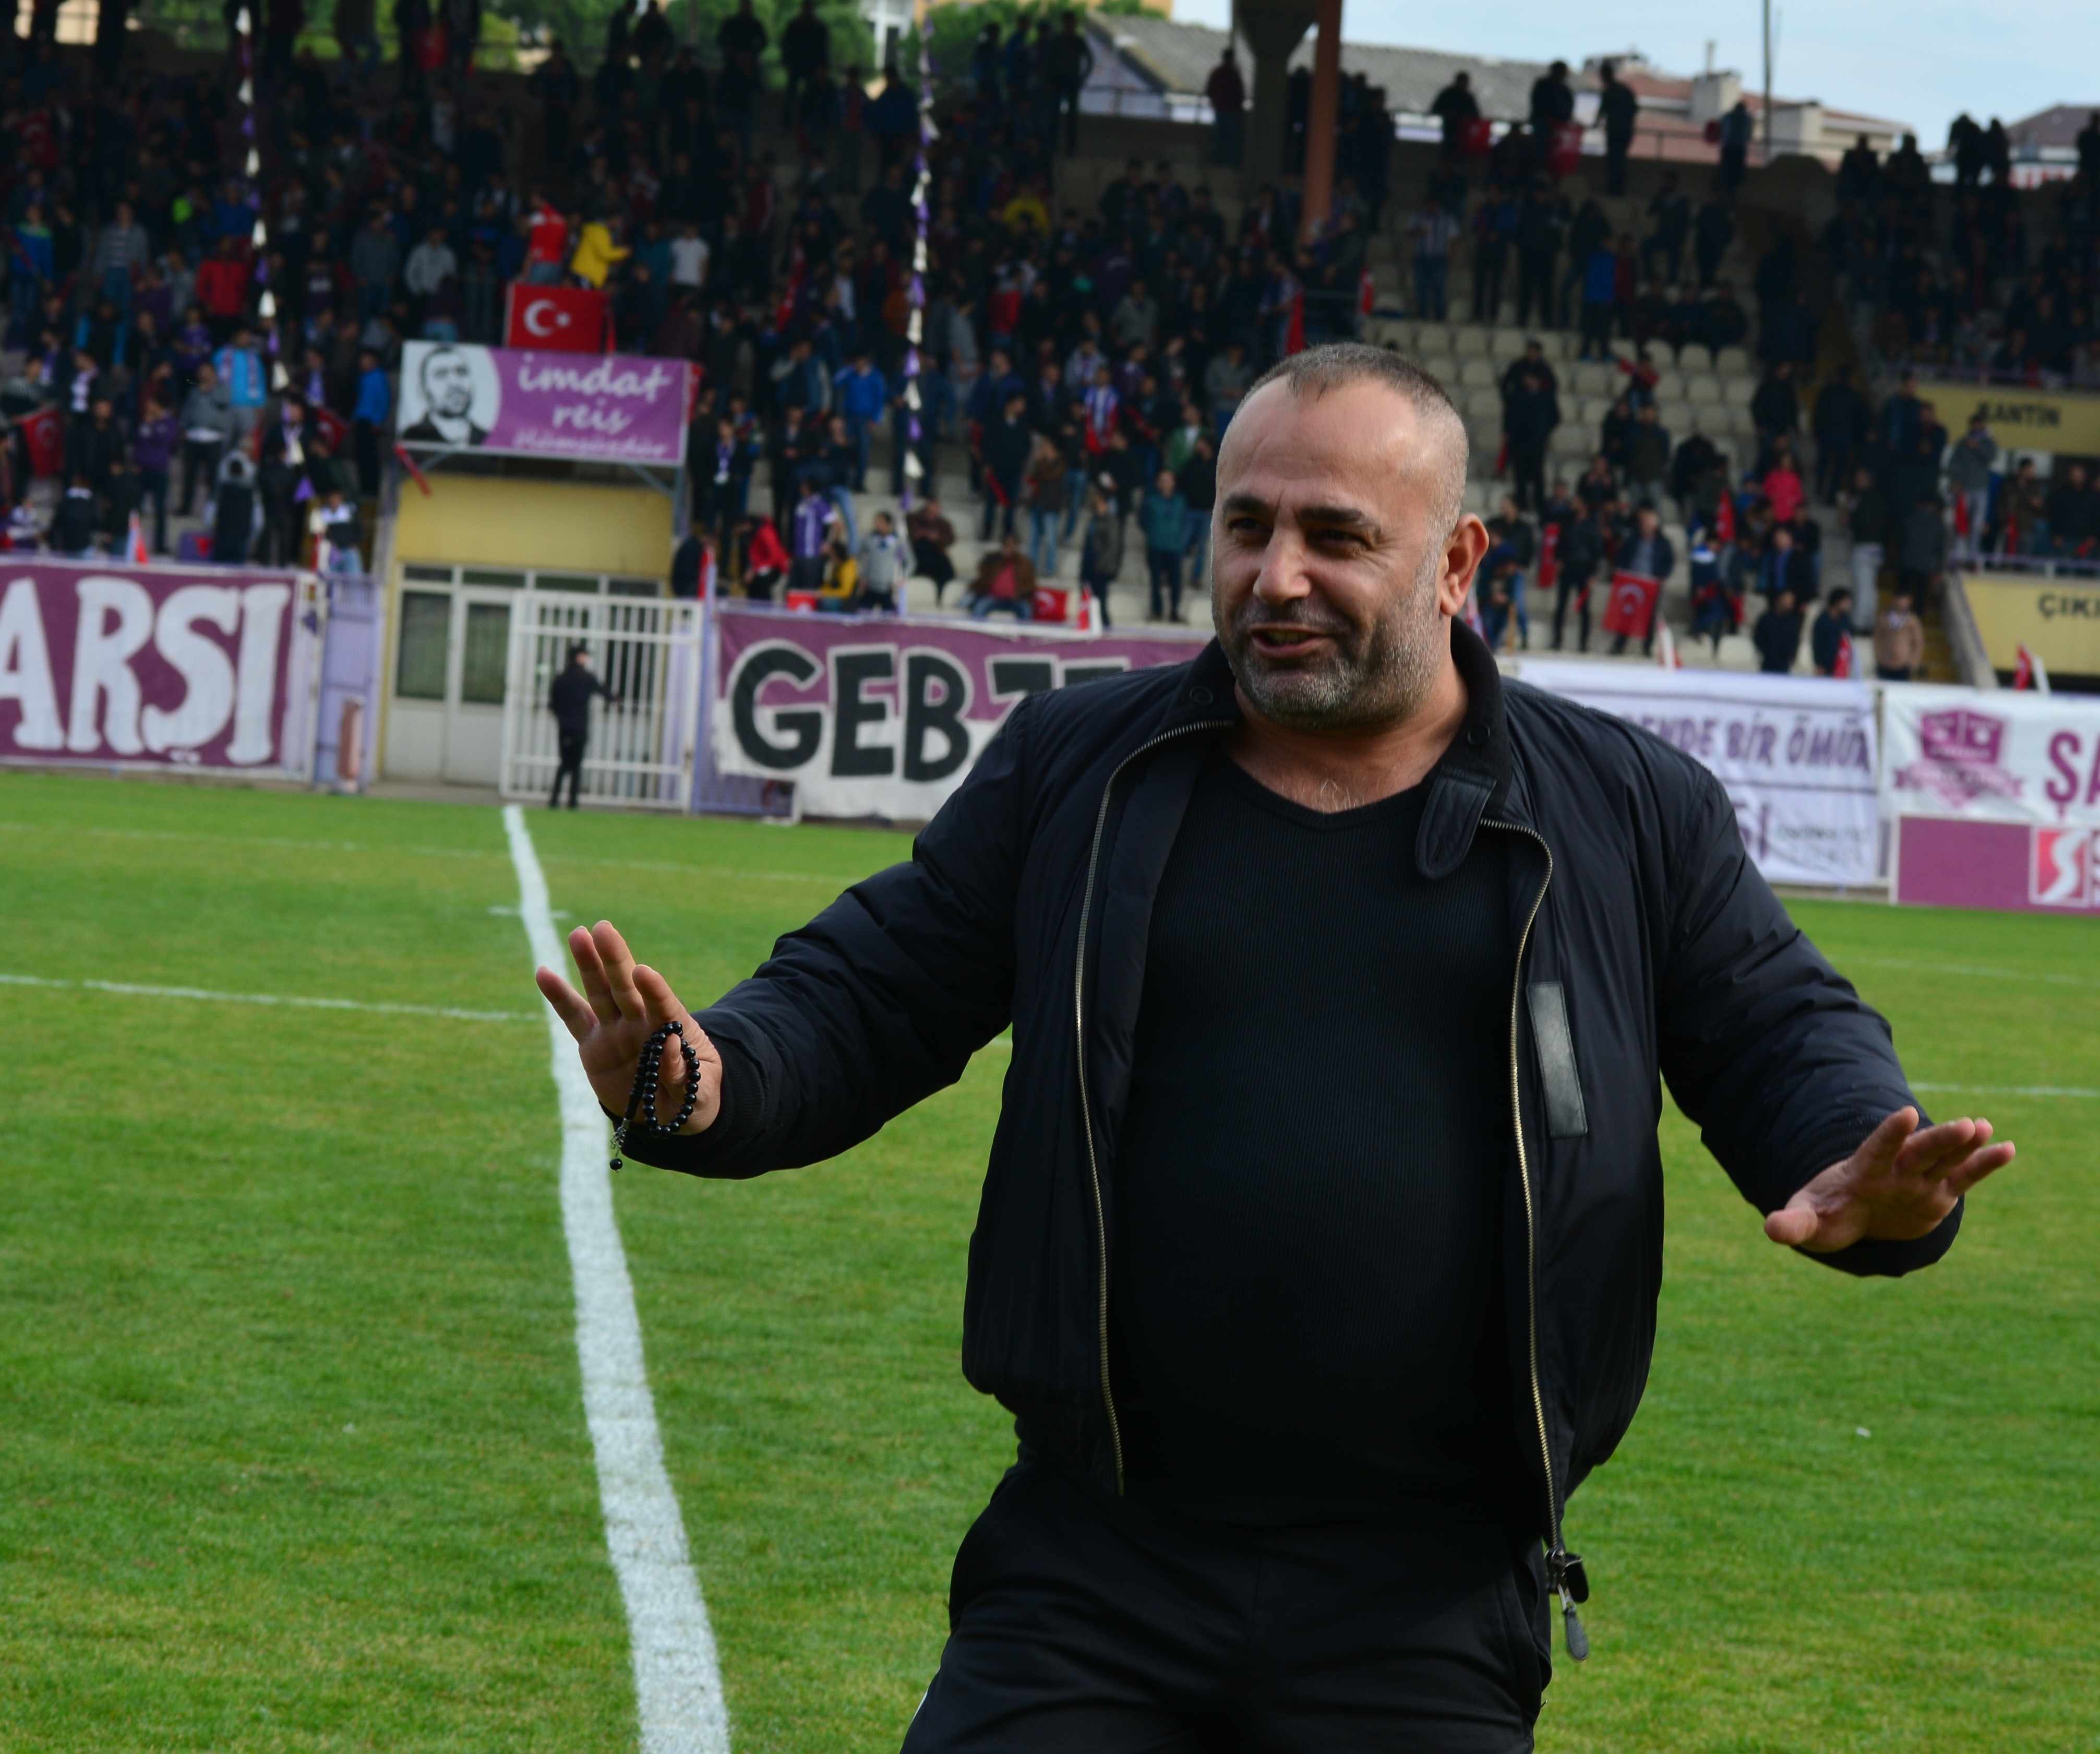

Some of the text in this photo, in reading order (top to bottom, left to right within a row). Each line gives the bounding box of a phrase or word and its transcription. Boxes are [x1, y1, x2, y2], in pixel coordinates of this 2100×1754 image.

[517, 352, 673, 404] imdat
[551, 397, 633, 435] reis
[728, 638, 1133, 783] GEB
